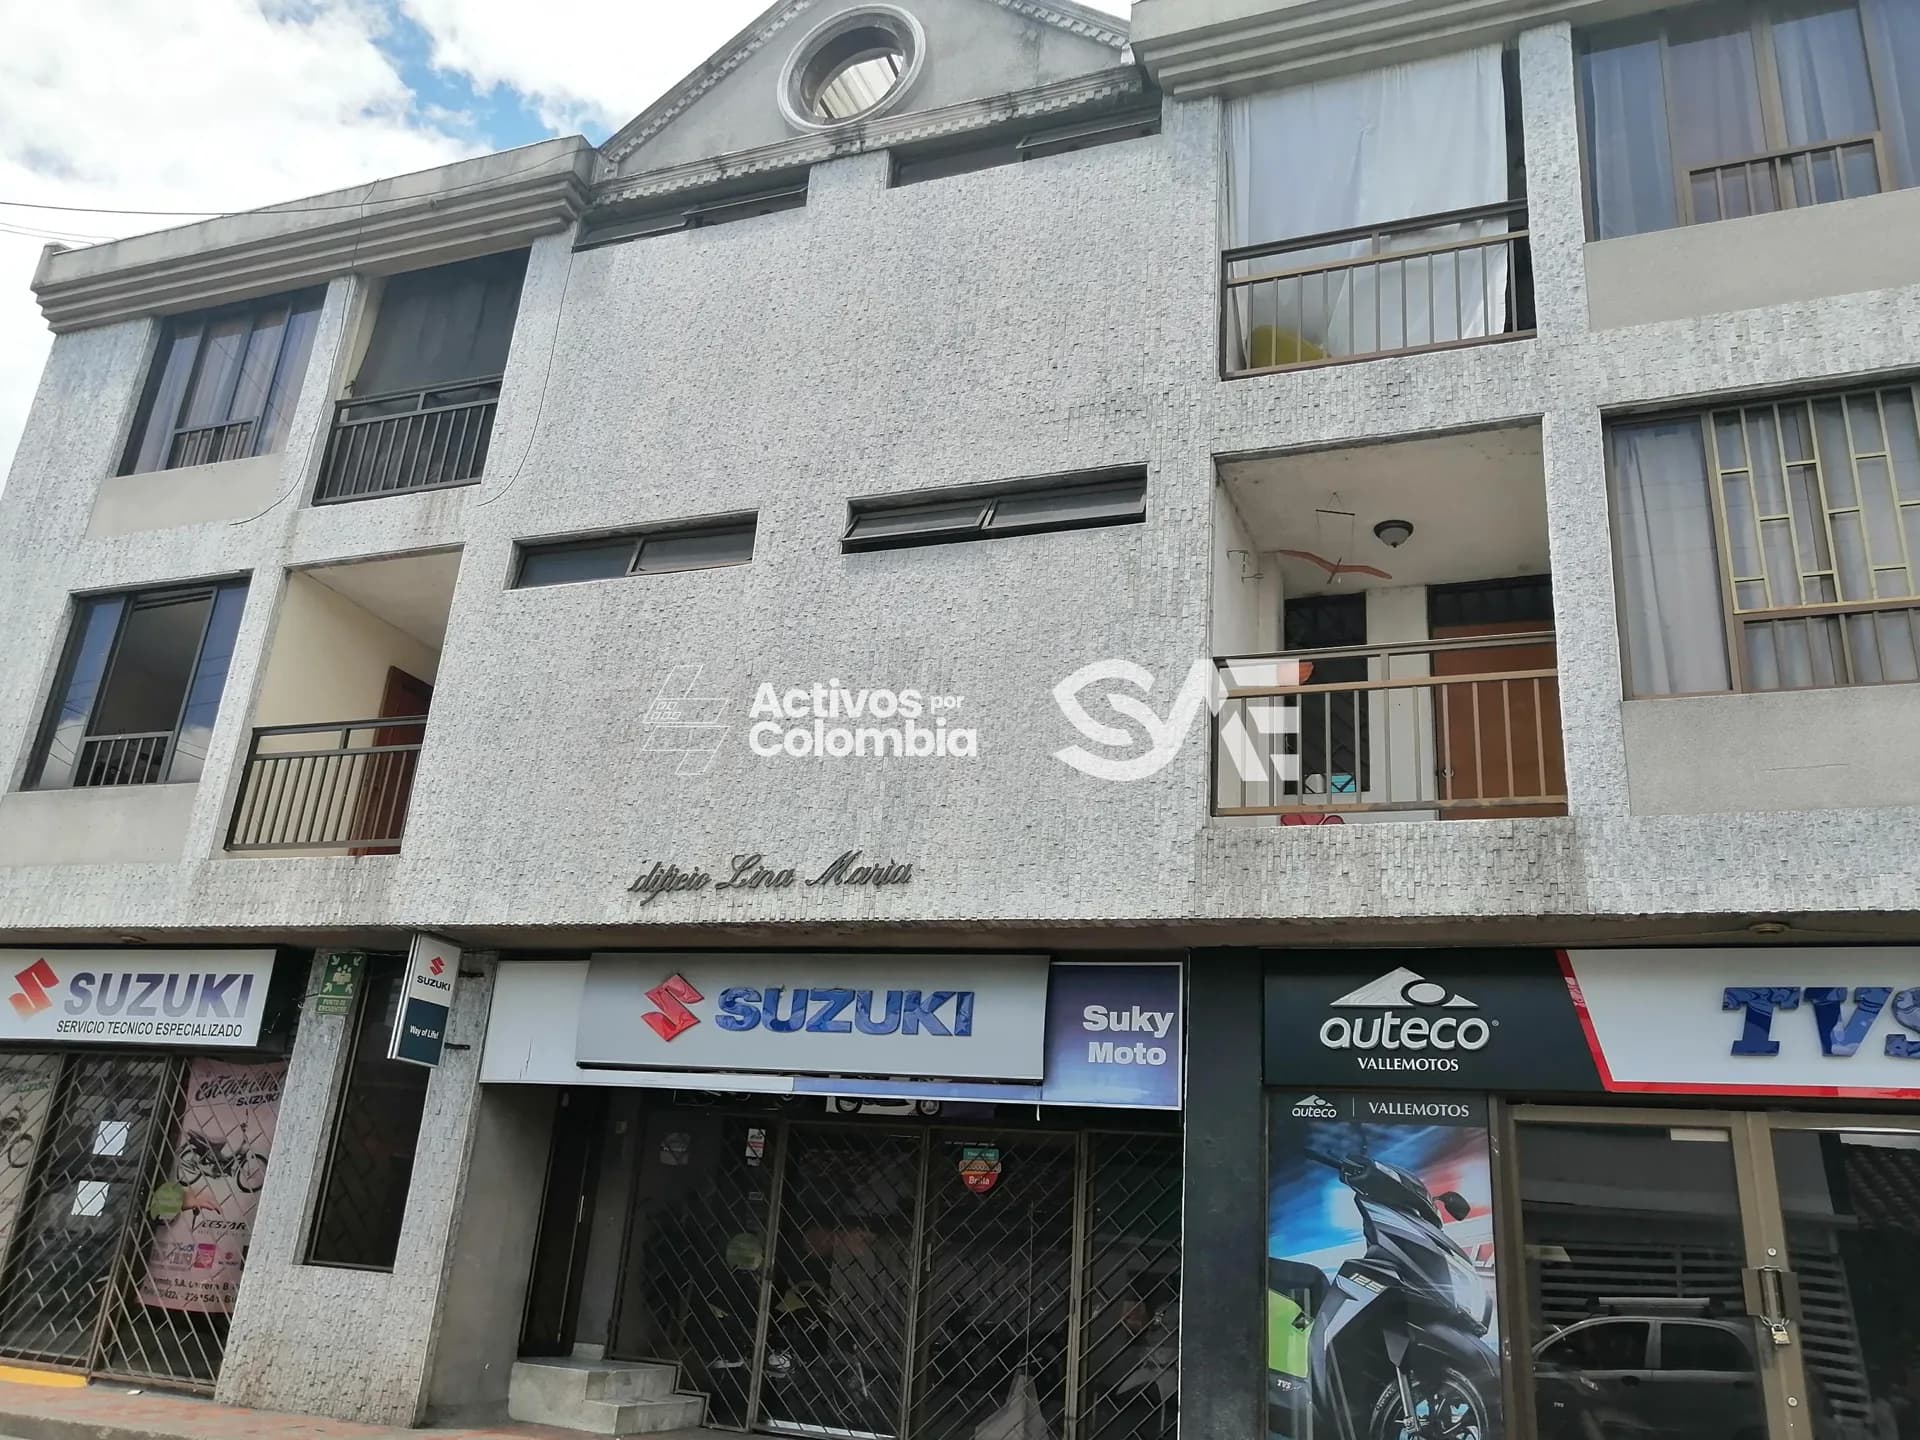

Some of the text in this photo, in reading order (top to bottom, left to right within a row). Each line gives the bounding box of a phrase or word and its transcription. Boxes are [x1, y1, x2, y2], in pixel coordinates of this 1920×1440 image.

[715, 853, 795, 891] Lina
[64, 972, 254, 1018] SUZUKI
[416, 975, 451, 991] SUZUKI
[715, 985, 975, 1037] SUZUKI
[1082, 1004, 1174, 1039] Suky
[1722, 986, 1920, 1060] TVS
[57, 1020, 242, 1038] SERVICIO TECNICO ESPECIALIZADO
[410, 1024, 439, 1039] Way of Life!
[1319, 1011, 1490, 1051] auteco
[1088, 1041, 1167, 1066] Moto
[1357, 1057, 1459, 1072] VALLEMOTOS
[1291, 1101, 1470, 1118] auteco VALLEMOTOS
[1349, 1272, 1388, 1294] 125
